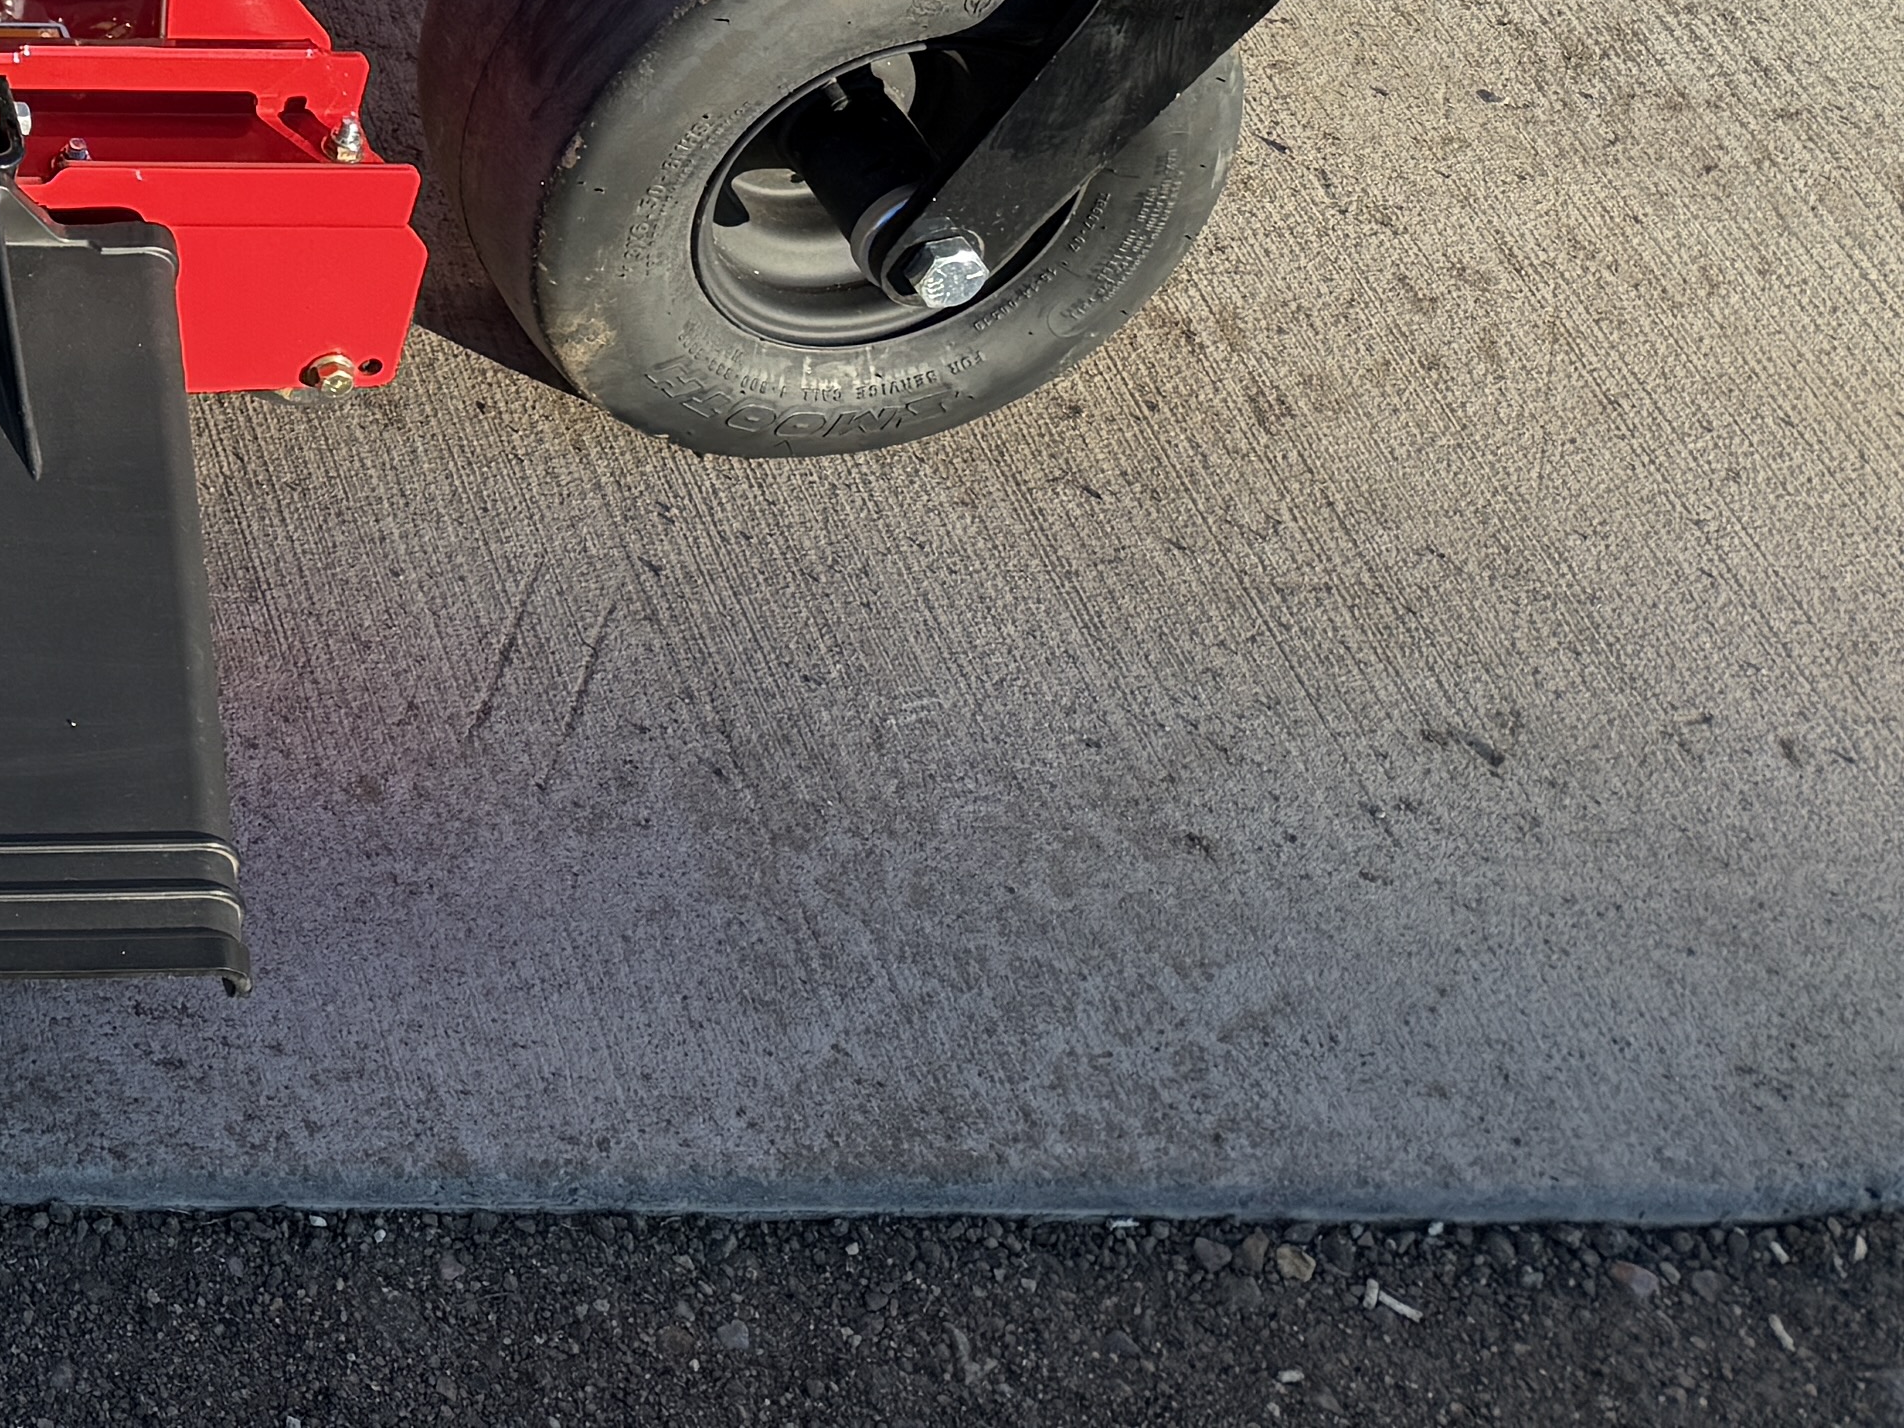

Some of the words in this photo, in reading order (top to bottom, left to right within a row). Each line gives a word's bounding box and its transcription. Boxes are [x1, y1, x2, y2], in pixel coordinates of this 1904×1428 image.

[946, 349, 988, 377] FOR
[645, 355, 958, 439] SMOOTH
[801, 385, 843, 404] CALL
[855, 370, 939, 401] SERVICE
